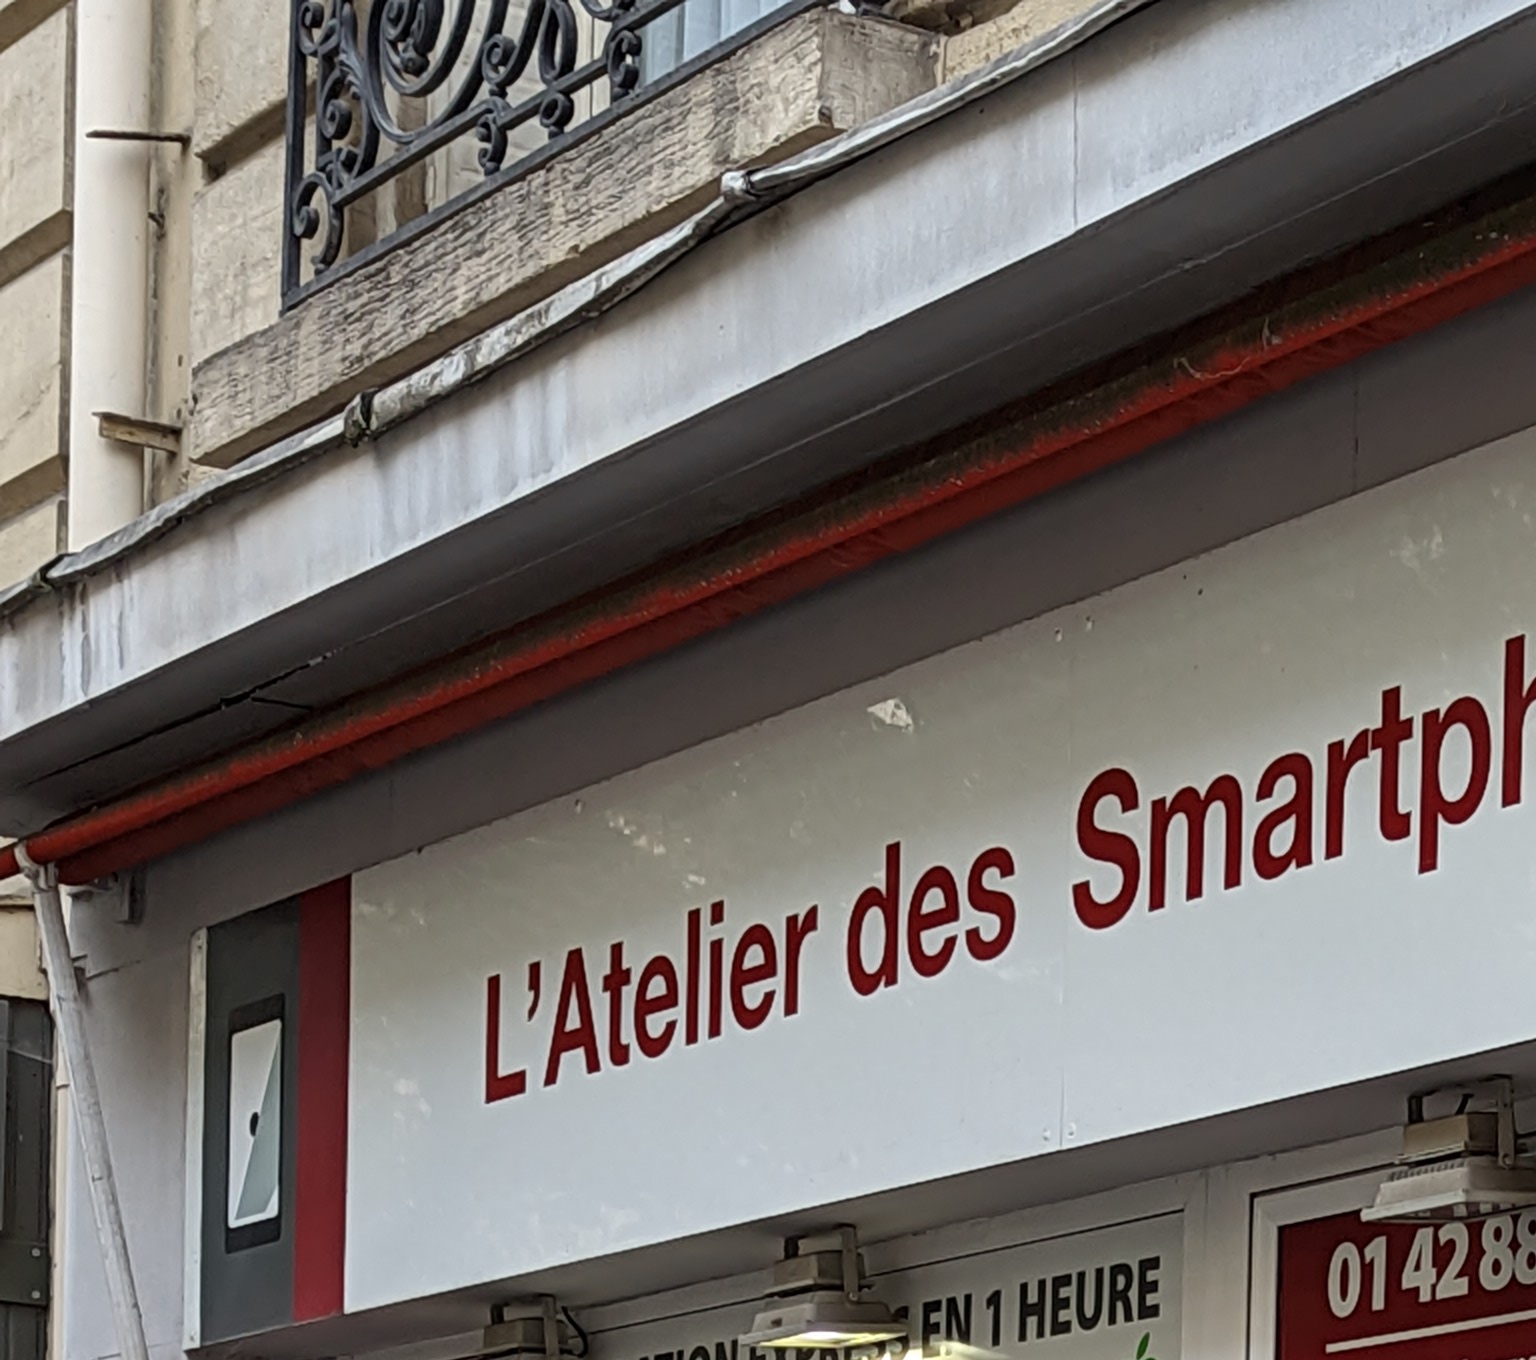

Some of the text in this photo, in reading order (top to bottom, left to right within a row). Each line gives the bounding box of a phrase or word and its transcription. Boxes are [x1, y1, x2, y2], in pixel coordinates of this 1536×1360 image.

[484, 899, 818, 1105] L'Atelier
[846, 841, 1016, 997] des
[922, 1293, 972, 1359] EN
[985, 1289, 1001, 1346] 1
[1019, 1257, 1160, 1342] HEURE
[1327, 1236, 1387, 1319] 01
[1402, 1219, 1470, 1303] 42
